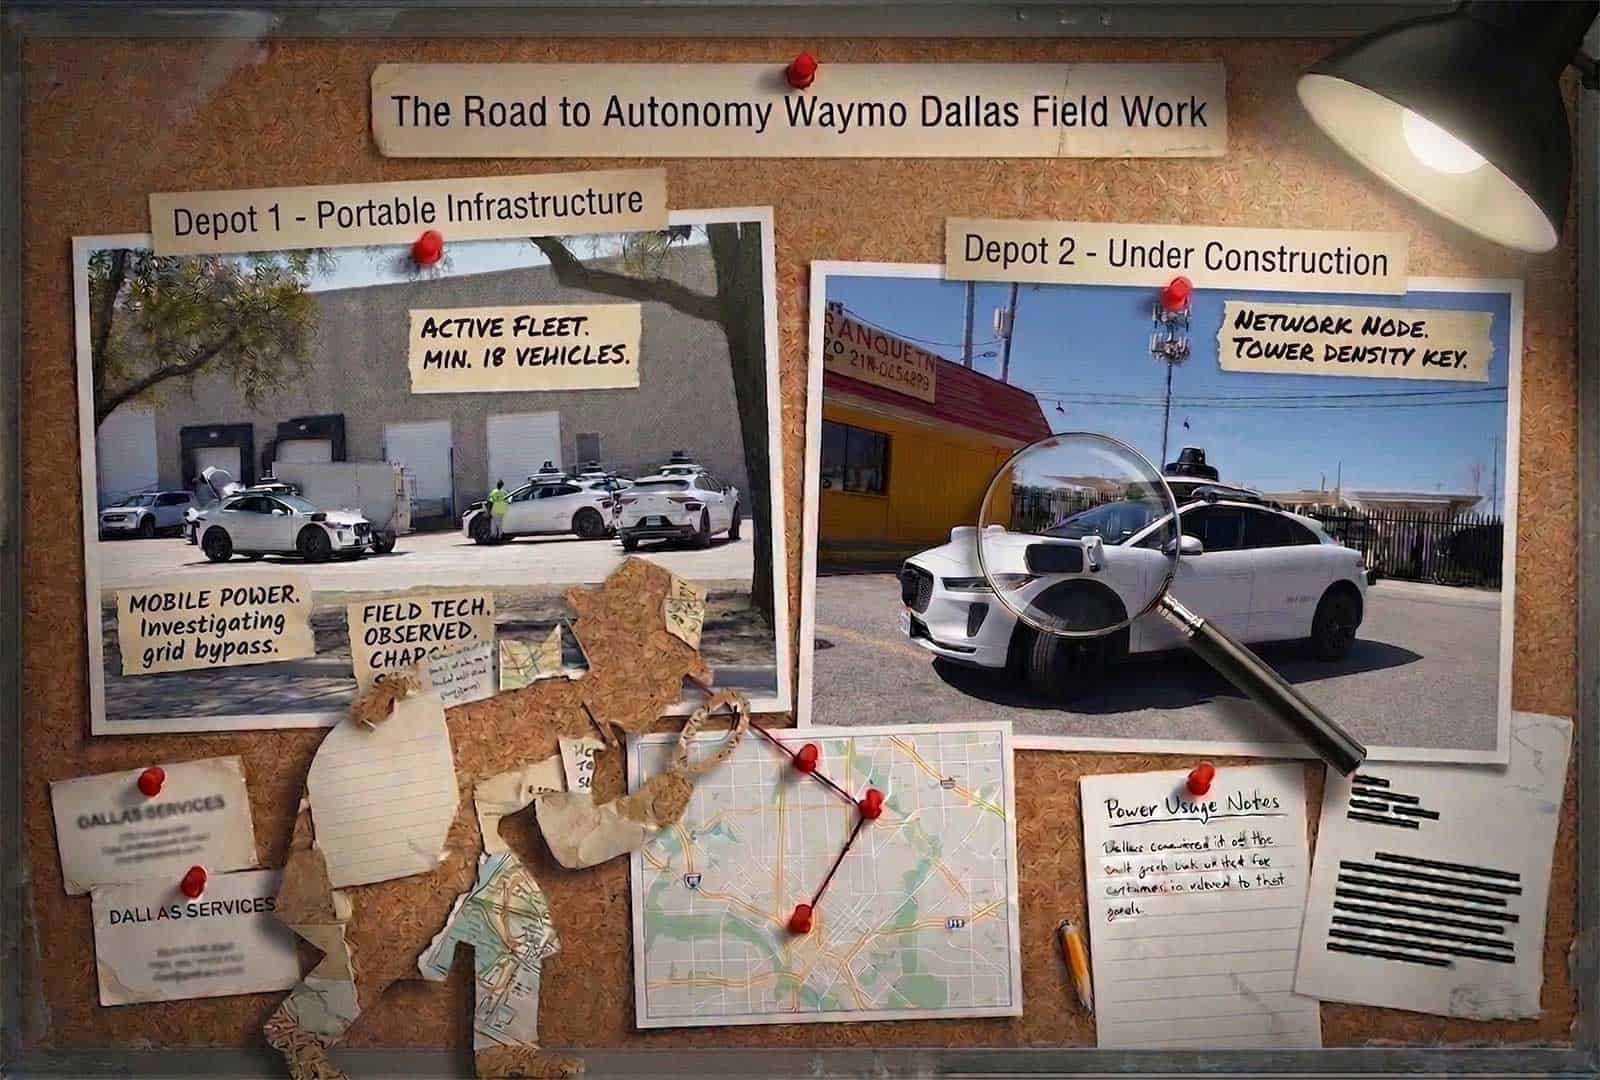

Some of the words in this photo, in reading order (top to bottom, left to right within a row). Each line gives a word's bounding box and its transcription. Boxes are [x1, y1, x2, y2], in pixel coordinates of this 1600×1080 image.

[391, 95, 450, 128] The
[464, 95, 547, 128] Road
[560, 96, 590, 128] to
[603, 95, 772, 134] Autonomy
[784, 95, 907, 134] Waymo
[921, 95, 1019, 128] Dallas
[1033, 95, 1108, 128] Field
[1120, 95, 1208, 128] Work
[173, 206, 257, 241] Depot
[268, 203, 281, 231] 1
[317, 195, 437, 229] Portable
[448, 187, 644, 222] Infrastructure
[965, 234, 1048, 270] Depot
[1059, 237, 1076, 265] 2
[1108, 239, 1195, 270] Under
[1204, 241, 1389, 277] Construction
[421, 317, 504, 339] ACTIVE
[512, 315, 590, 338] FLEET.
[1234, 309, 1353, 335] NETWORK
[1361, 316, 1429, 339] NODE.
[423, 349, 472, 369] MIN.
[483, 347, 506, 368] 18
[516, 344, 630, 367] VEHICLES.
[1232, 336, 1315, 362] TOWER
[1323, 343, 1416, 367] DENSITY
[1422, 348, 1468, 369] KEY.
[129, 590, 211, 613] MOBILE
[220, 584, 300, 607] POWER.
[363, 602, 422, 624] FIELD
[431, 597, 491, 619] TECH.
[140, 610, 286, 638] Investigating
[364, 620, 478, 646] OBSERVED.
[143, 638, 186, 668] grid
[194, 637, 279, 663] bypass.
[77, 806, 142, 830] DALLAS
[143, 794, 225, 819] SERVICES
[1104, 799, 1158, 819] Power
[1165, 794, 1217, 825] Usage
[1227, 790, 1281, 811] Notes
[185, 896, 276, 918] SERVICES
